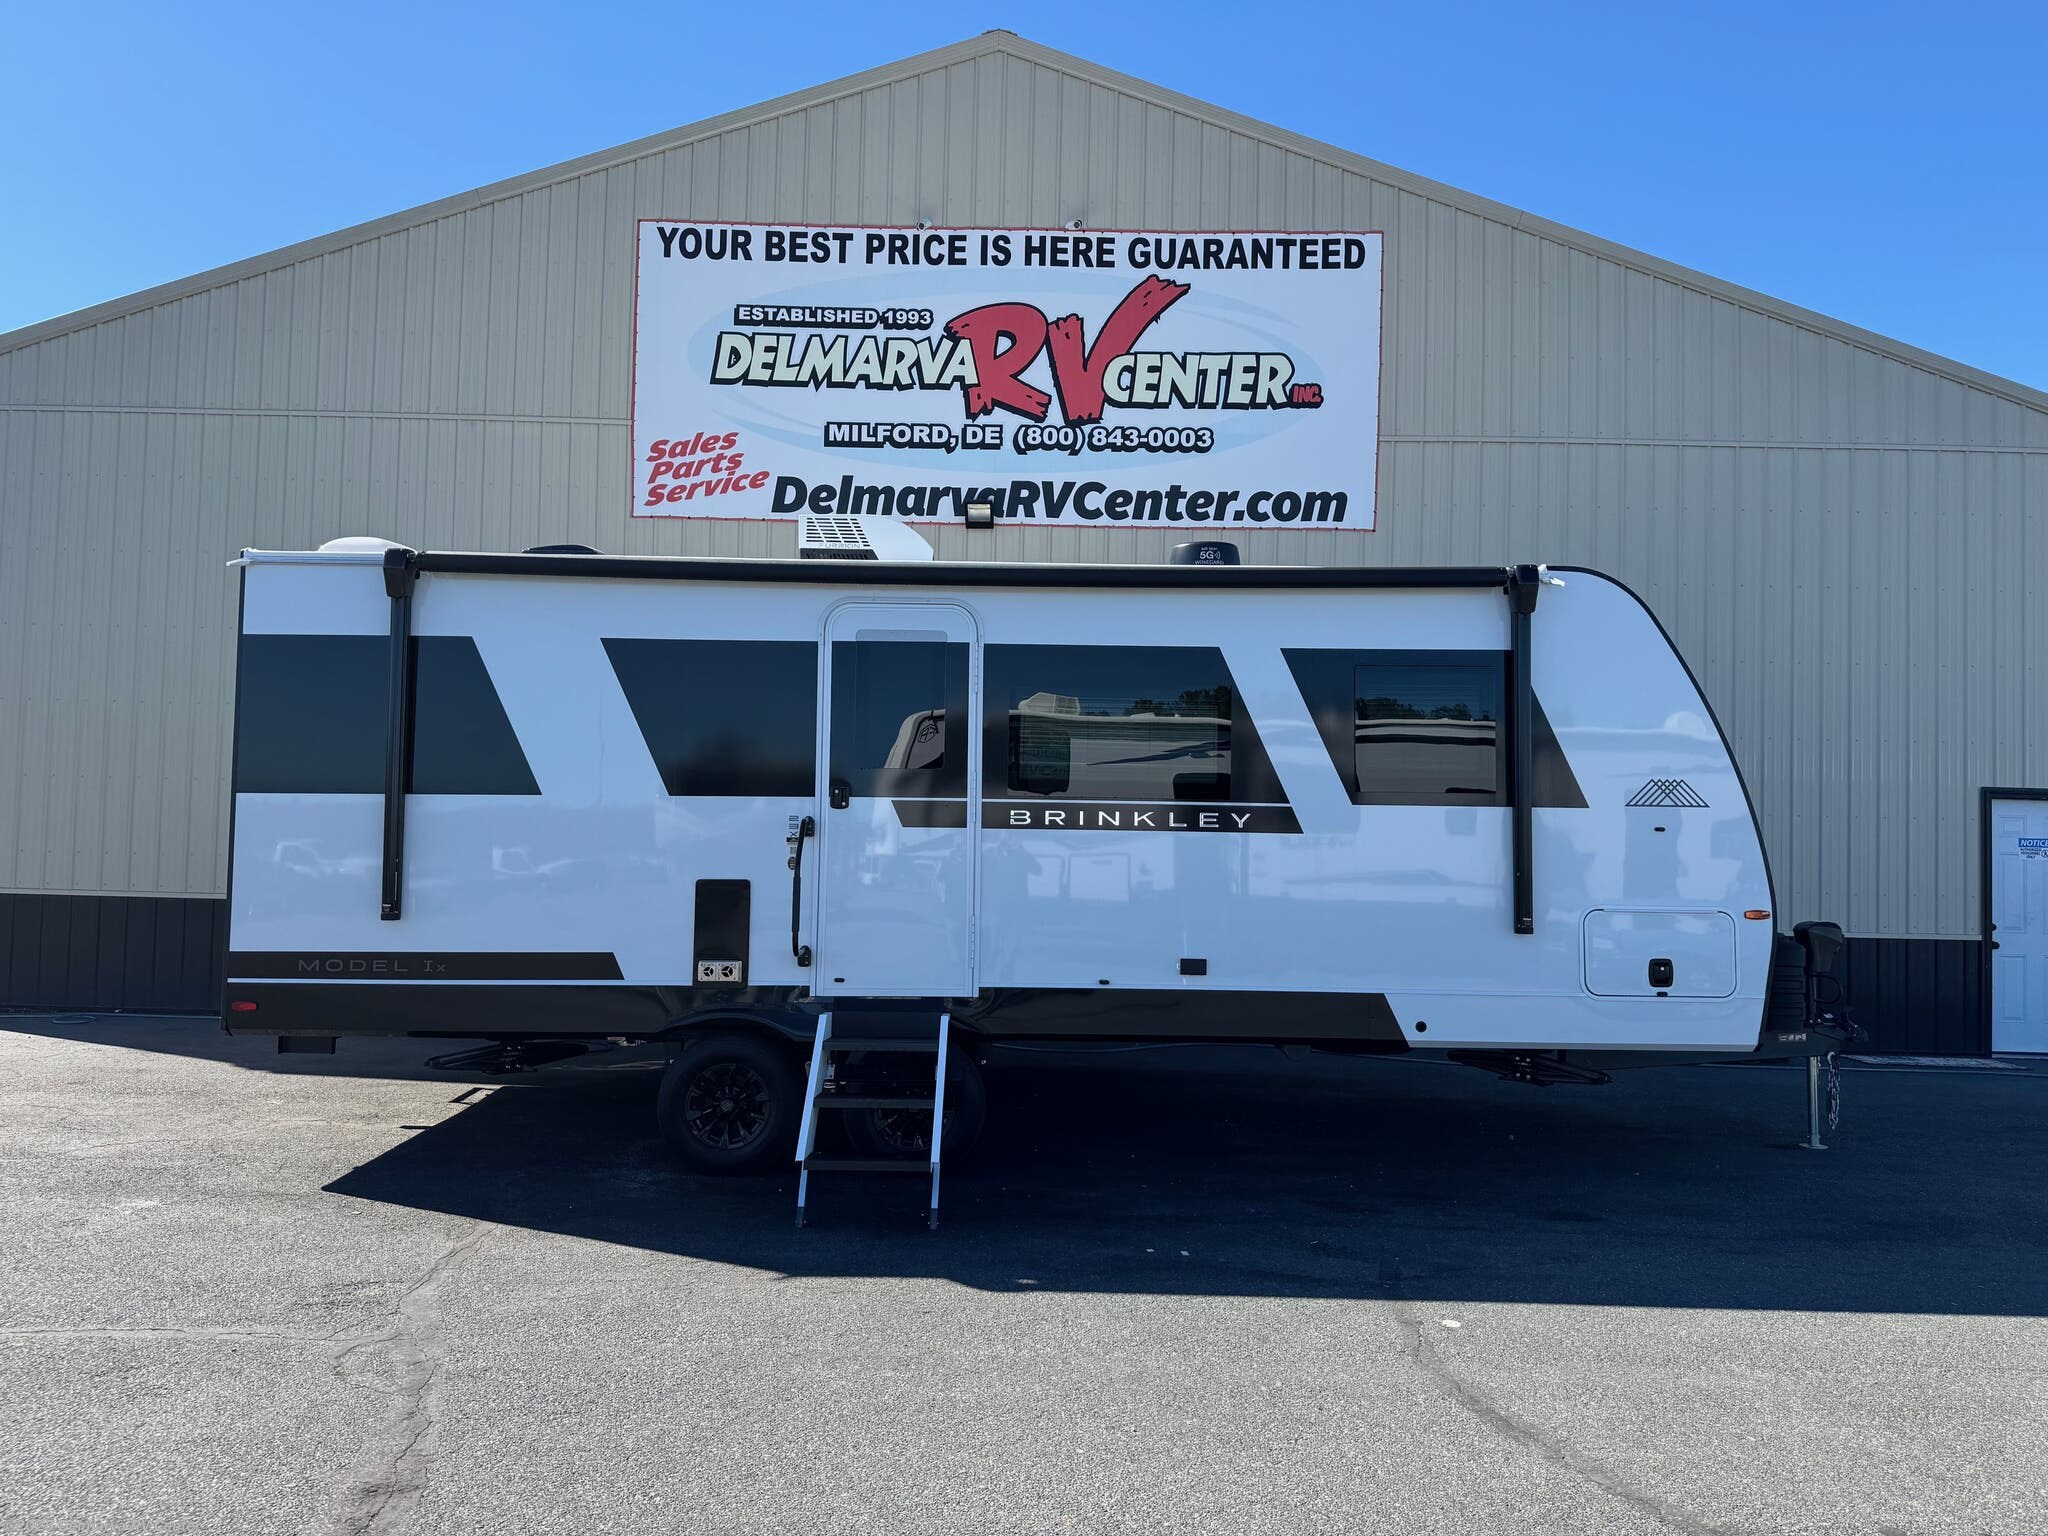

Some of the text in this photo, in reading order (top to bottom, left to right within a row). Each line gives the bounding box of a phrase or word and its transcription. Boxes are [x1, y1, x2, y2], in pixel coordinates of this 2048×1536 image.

[657, 226, 1366, 270] YOUR BEST PRICE IS HERE GUARANTEED
[736, 305, 933, 328] ESTABLISHED 1993
[710, 331, 981, 391] DELMARVA
[943, 274, 1191, 426] RV
[1101, 351, 1296, 410] CENTER
[646, 431, 739, 462] Sales
[824, 421, 1214, 454] MILFORD, DE (800) 843-0003
[648, 452, 744, 484] Parts
[644, 470, 770, 507] Service
[771, 475, 1348, 522] DelmarvaRVCenter.com
[1200, 551, 1214, 560] 5G
[1010, 810, 1251, 828] BRINKLEY
[298, 959, 409, 972] MODEL
